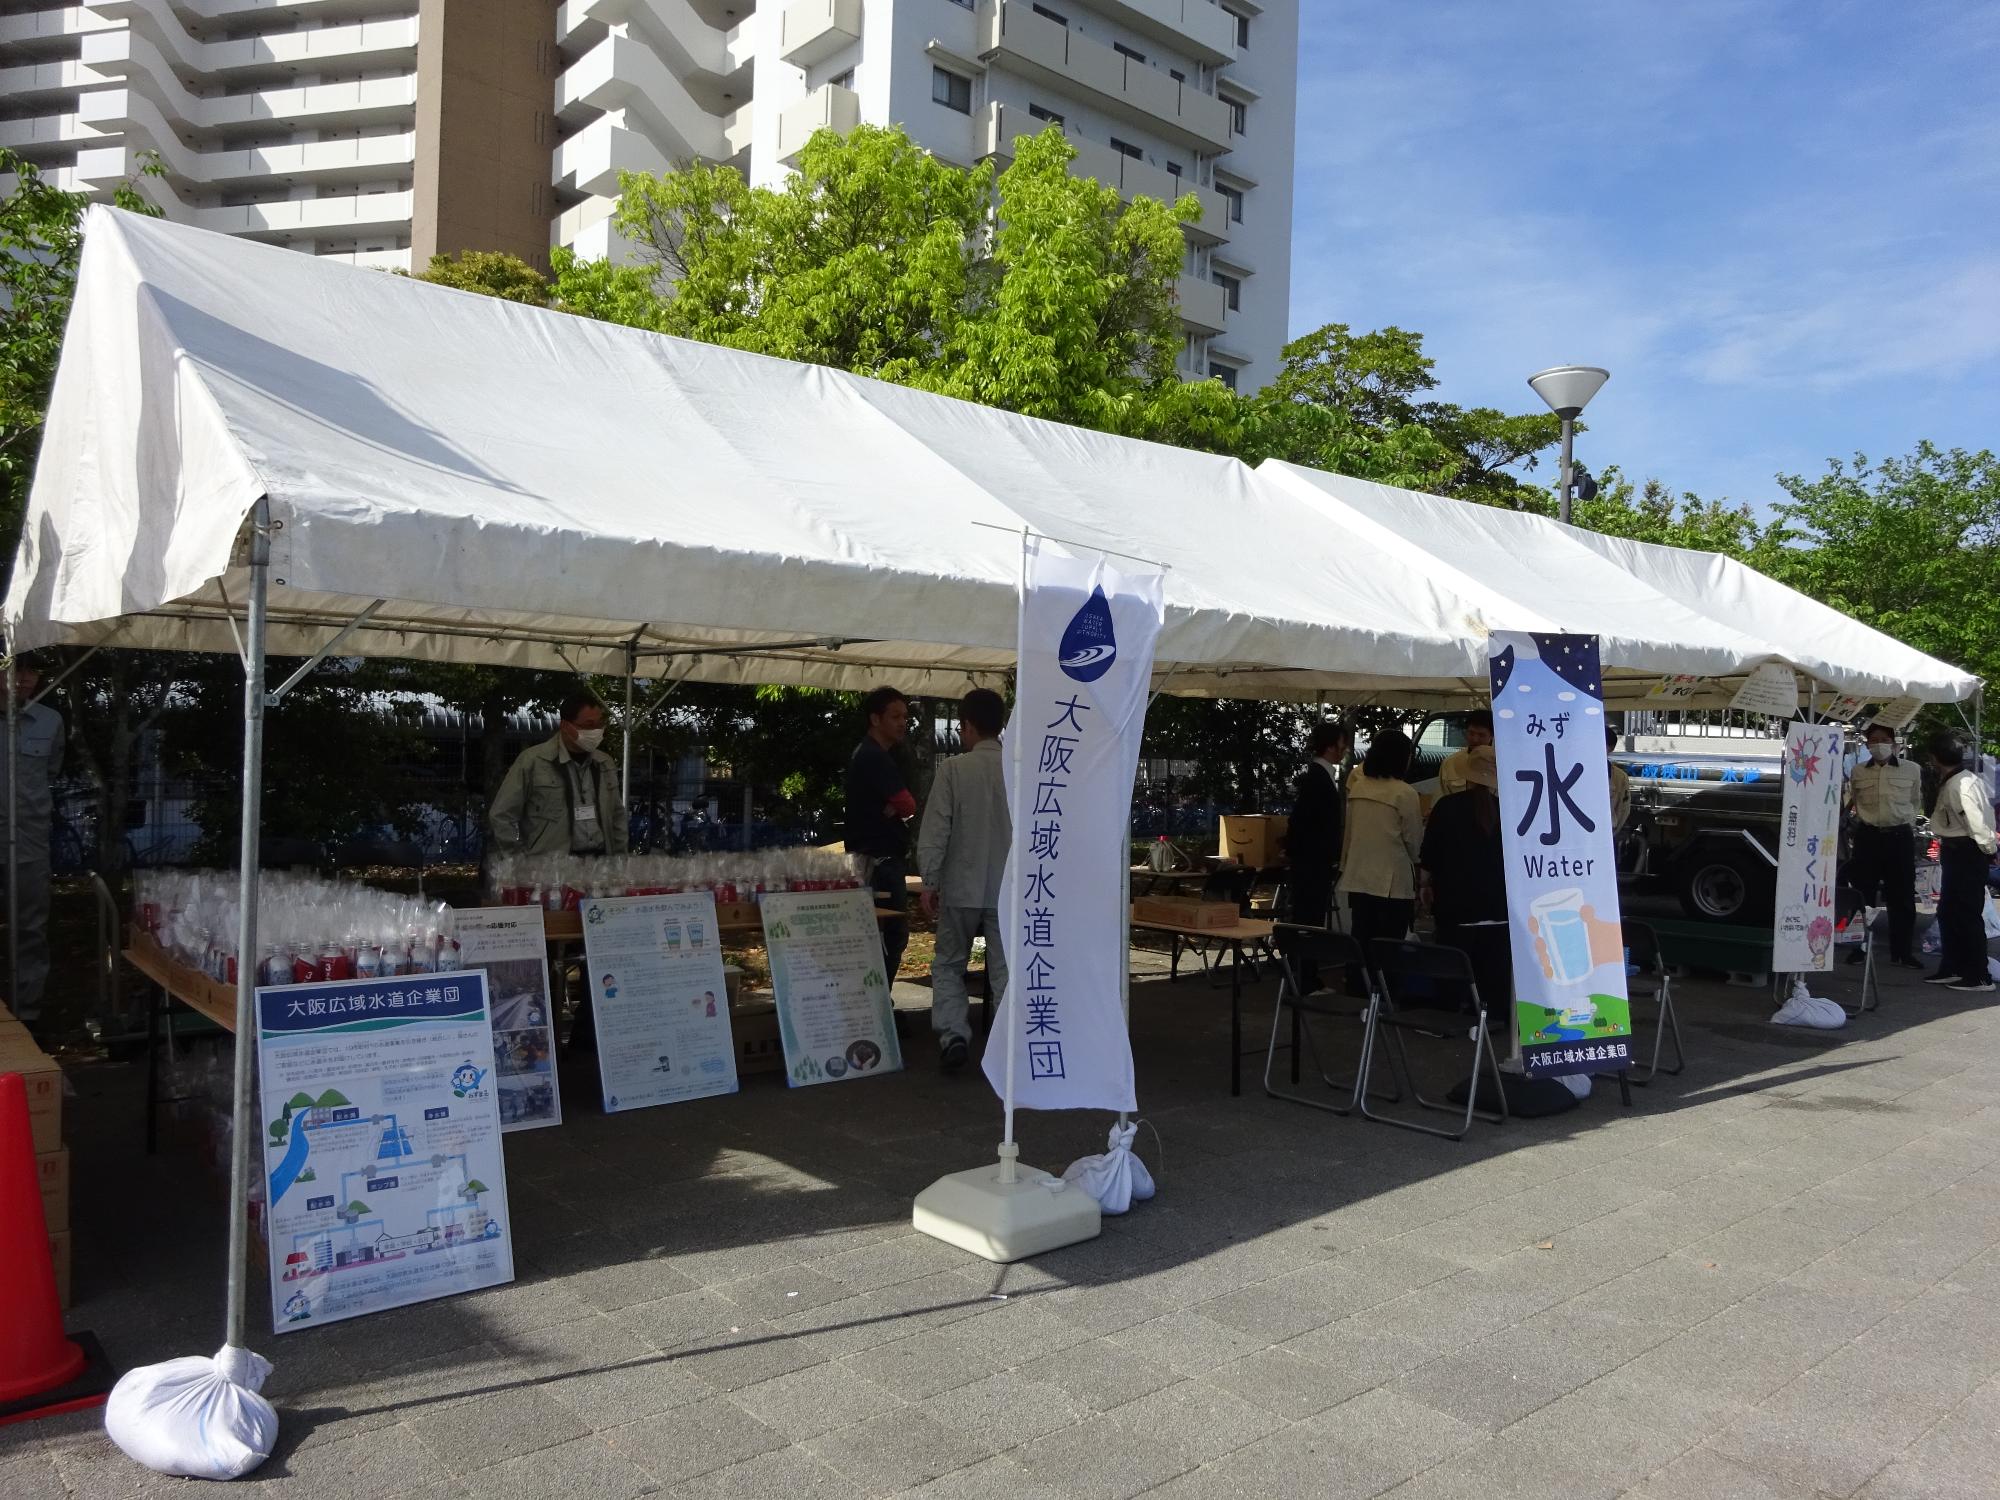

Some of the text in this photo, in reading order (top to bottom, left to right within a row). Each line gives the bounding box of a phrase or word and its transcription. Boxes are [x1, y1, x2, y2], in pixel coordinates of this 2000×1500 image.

[1526, 712, 1570, 739] みず
[1721, 767, 1762, 785] 水道
[1515, 742, 1596, 846] 水
[1817, 732, 1840, 908] スーパーボール
[1523, 854, 1596, 880] Water
[1803, 834, 1820, 905] すくい
[1022, 693, 1092, 1083] 大阪広域水道企業団
[286, 985, 461, 1018] 大阪広域水道企業団
[1530, 1043, 1628, 1068] 大阪広域水道企業団
